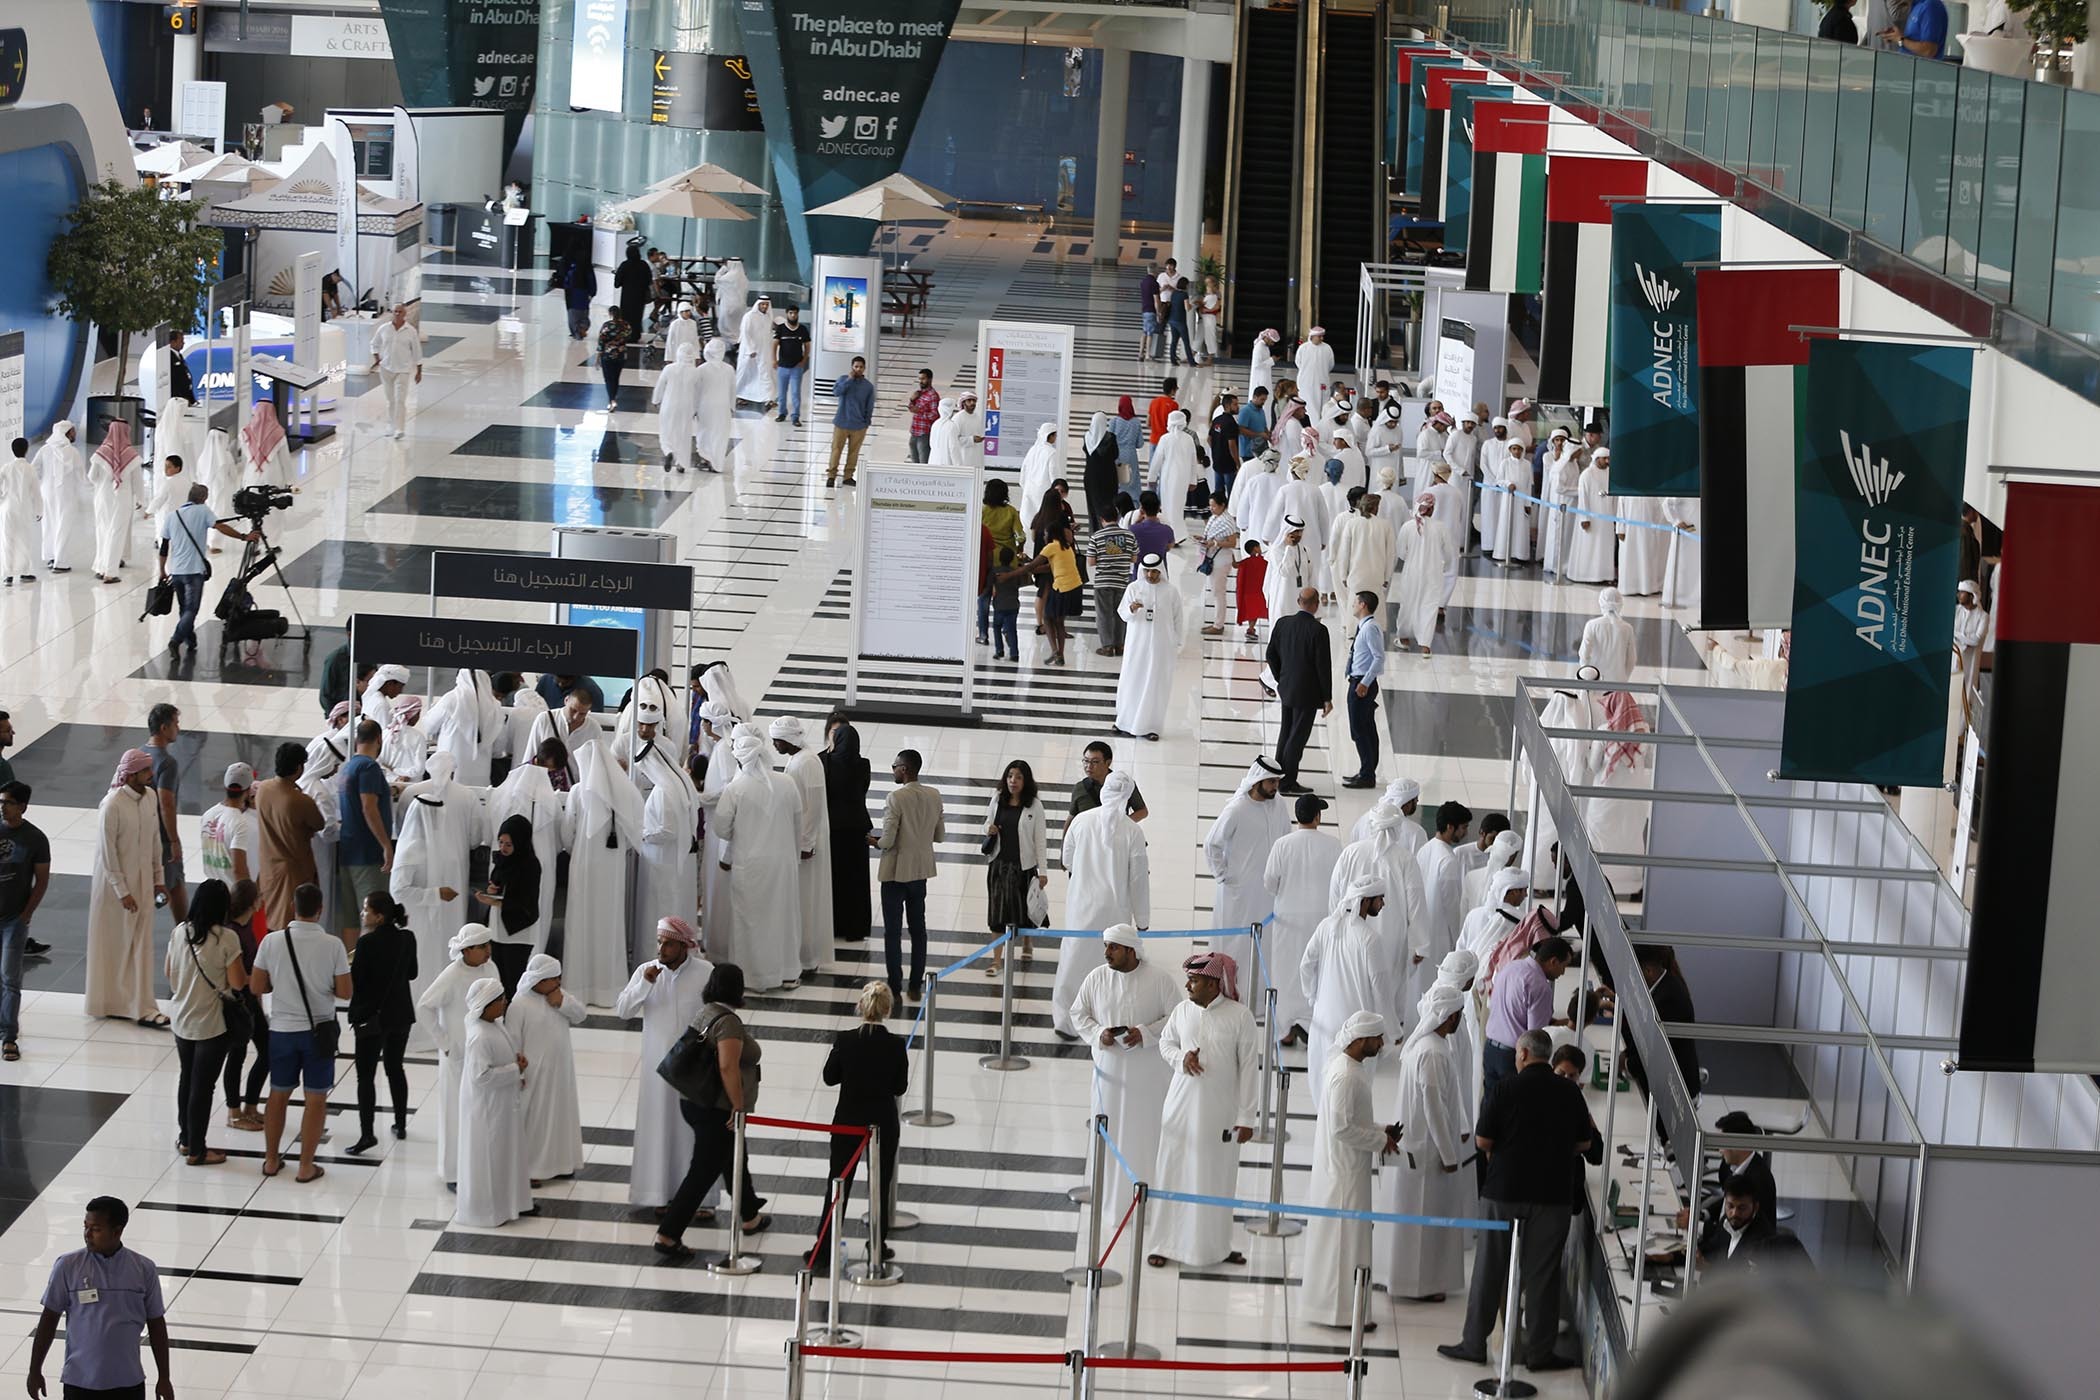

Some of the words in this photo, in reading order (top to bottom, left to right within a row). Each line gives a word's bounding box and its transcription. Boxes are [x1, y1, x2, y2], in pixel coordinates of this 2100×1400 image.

[170, 12, 183, 29] 6
[470, 8, 483, 24] in
[485, 9, 513, 24] Abu
[792, 13, 825, 32] The
[827, 15, 874, 37] place
[876, 19, 894, 36] to
[900, 21, 945, 37] meet
[343, 23, 378, 35] ARTS
[326, 40, 339, 50] &
[342, 38, 391, 52] CRAFT
[810, 37, 828, 55] in
[829, 38, 867, 57] Abu
[869, 41, 922, 59] Dhabi
[477, 50, 535, 64] adnec.ae
[822, 86, 900, 103] adnec.ae
[816, 141, 896, 158] ADNECGroup
[1653, 320, 1673, 409] ADNEC
[874, 486, 898, 495] ARENA
[899, 487, 936, 497] SCHEDULE
[937, 490, 956, 498] HALL
[1897, 526, 1905, 549] مركز
[1906, 526, 1916, 550] Centre
[493, 567, 517, 584] هنا
[1903, 549, 1913, 585] Exhibition
[520, 571, 587, 589] التسجيل
[590, 576, 632, 593] الرجاء
[1855, 519, 1891, 651] ADNEC
[1901, 585, 1911, 617] National
[1900, 617, 1908, 639] Dhabi
[419, 631, 445, 649] هنا
[449, 635, 521, 655] التسجيل
[1898, 638, 1906, 653] Abu
[526, 640, 572, 660] الرجاء
